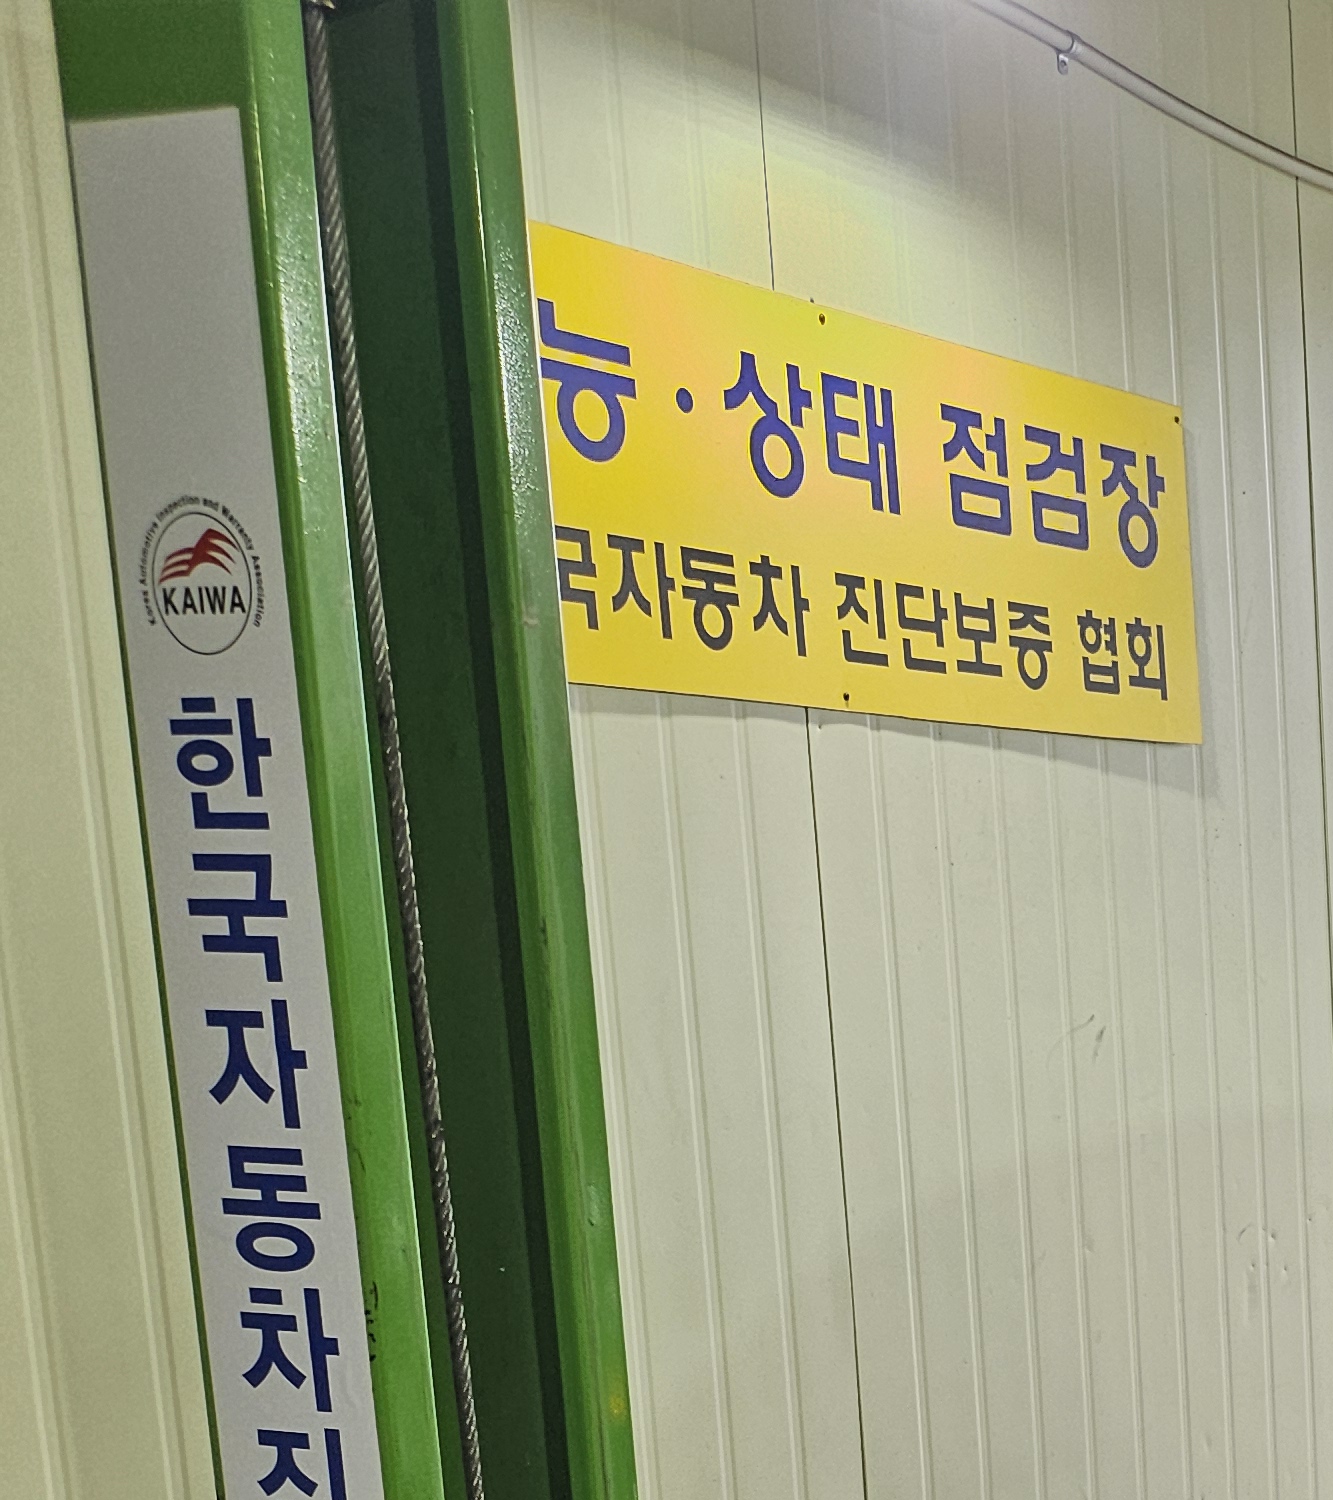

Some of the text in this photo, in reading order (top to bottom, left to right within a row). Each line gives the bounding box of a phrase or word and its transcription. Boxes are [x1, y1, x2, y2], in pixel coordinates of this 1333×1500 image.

[939, 402, 1166, 568] 점검장
[162, 585, 247, 616] KAIWA
[834, 572, 1053, 691] 진단보증
[1077, 609, 1168, 701] 협회
